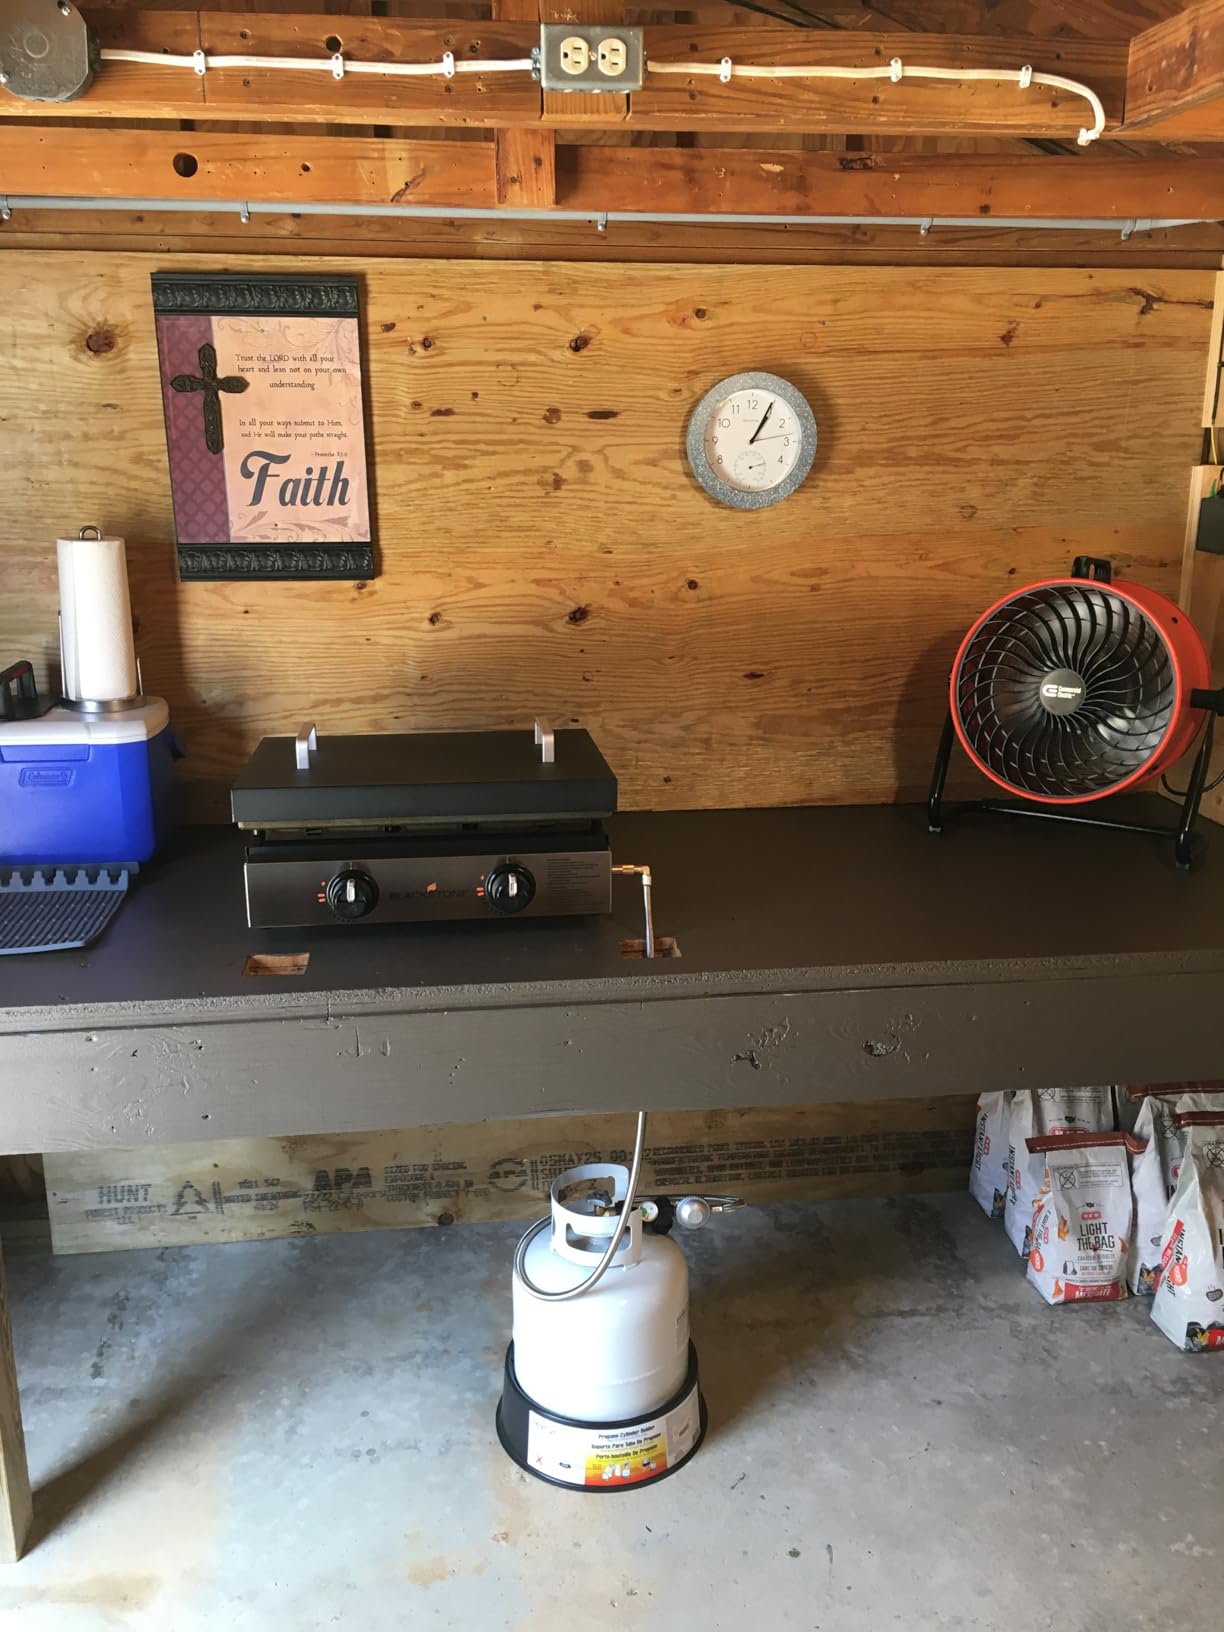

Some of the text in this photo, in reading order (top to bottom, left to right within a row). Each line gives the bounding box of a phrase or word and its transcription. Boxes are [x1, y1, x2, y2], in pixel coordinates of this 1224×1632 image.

[235, 353, 335, 365] Trust the LORD with all your
[237, 365, 255, 373] heart
[258, 365, 270, 373] and
[272, 365, 287, 373] lean
[314, 367, 330, 376] your
[732, 404, 740, 414] 11
[747, 400, 759, 409] 12
[248, 418, 257, 426] all
[259, 420, 273, 429] your
[276, 420, 292, 429] ways
[294, 419, 315, 427] submit
[718, 418, 731, 428] 10
[778, 418, 786, 428] 2
[241, 430, 252, 438] and
[264, 430, 276, 438] will
[278, 430, 292, 438] make
[294, 432, 307, 440] your
[711, 436, 719, 446] 9
[783, 437, 790, 447] 3
[717, 455, 723, 464] 8
[777, 455, 784, 464] 4
[240, 450, 351, 507] Faith
[314, 1167, 372, 1191] APA
[97, 1184, 152, 1204] HUNT
[1079, 1222, 1108, 1237] LIGHT
[1077, 1235, 1115, 1251] THE BAG
